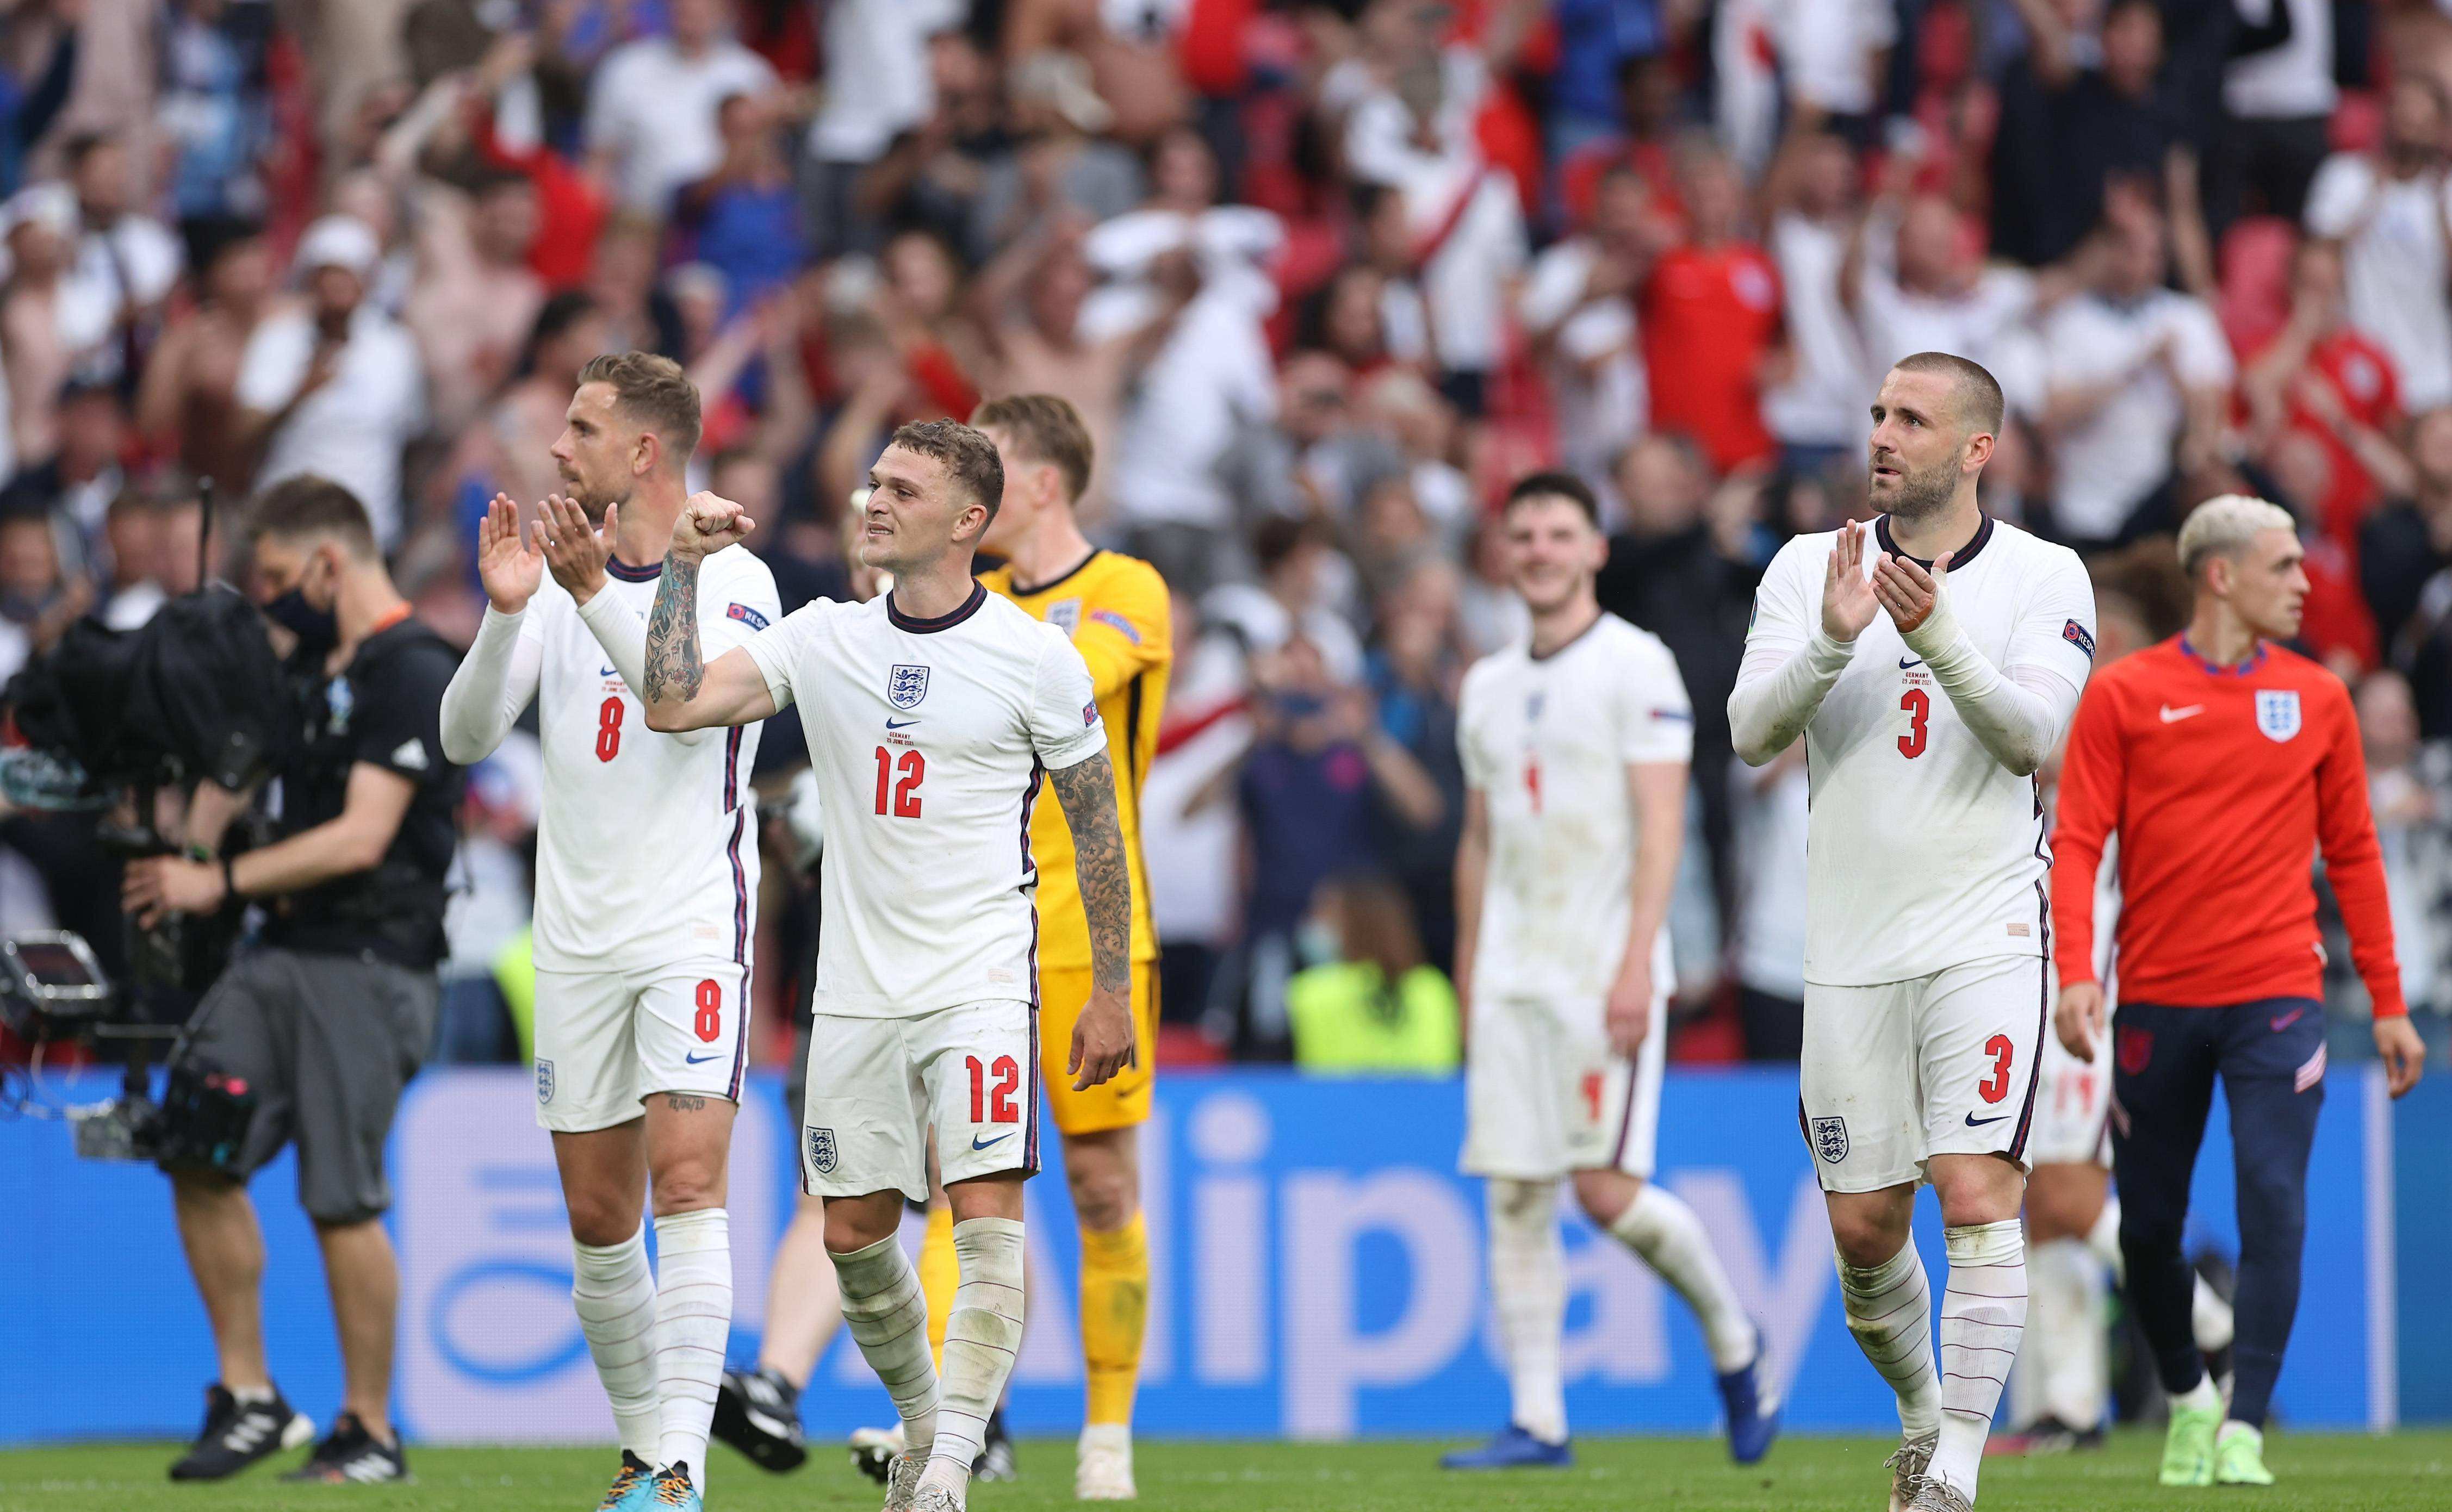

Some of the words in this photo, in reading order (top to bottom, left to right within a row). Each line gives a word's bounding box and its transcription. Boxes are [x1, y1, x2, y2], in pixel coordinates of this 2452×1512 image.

[595, 696, 624, 762] 8
[1897, 688, 1929, 759] 3
[875, 746, 925, 819] 12
[695, 979, 721, 1042] 8
[966, 1055, 1019, 1123] 12
[1979, 1034, 2013, 1104] 3
